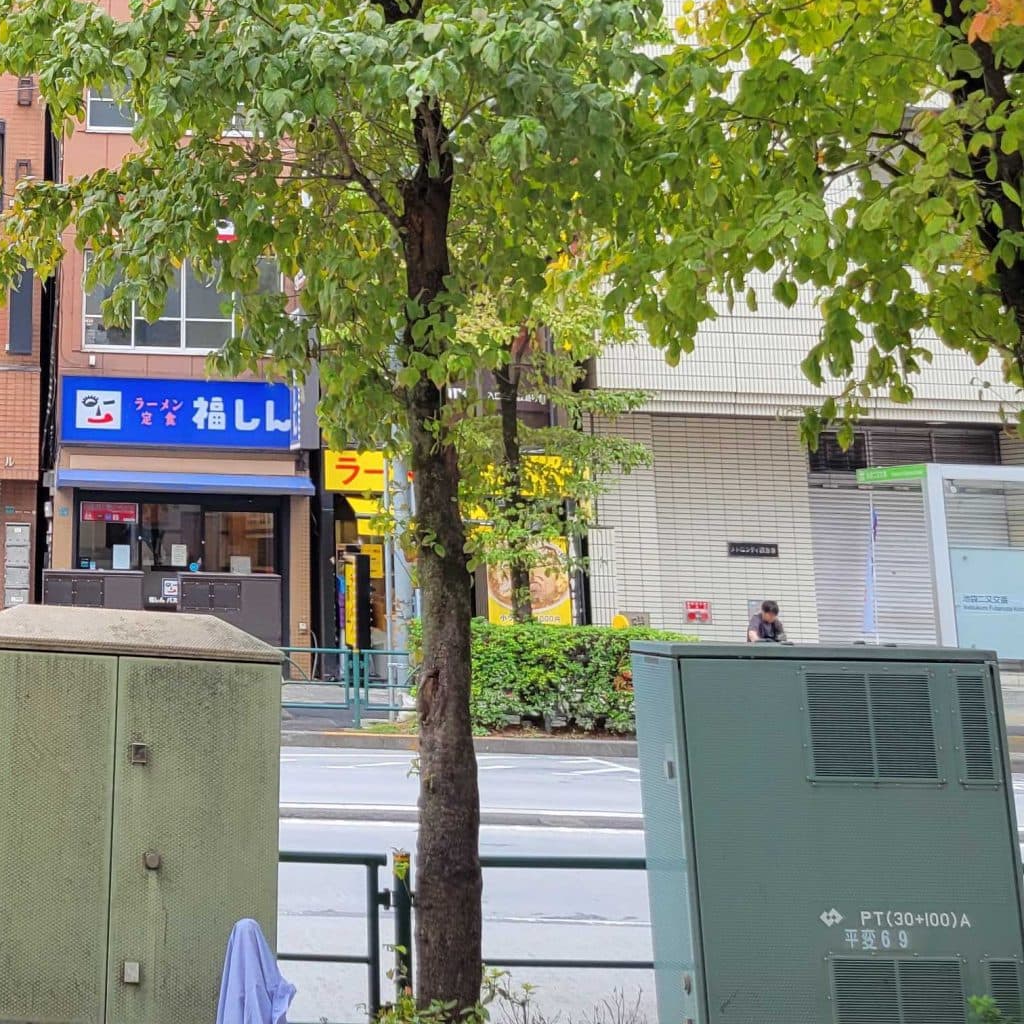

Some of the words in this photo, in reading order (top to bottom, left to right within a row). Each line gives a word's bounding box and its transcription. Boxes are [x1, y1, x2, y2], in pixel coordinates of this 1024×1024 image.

[134, 397, 184, 412] ラーメン
[140, 411, 177, 426] 定食
[192, 396, 291, 431] 福しん
